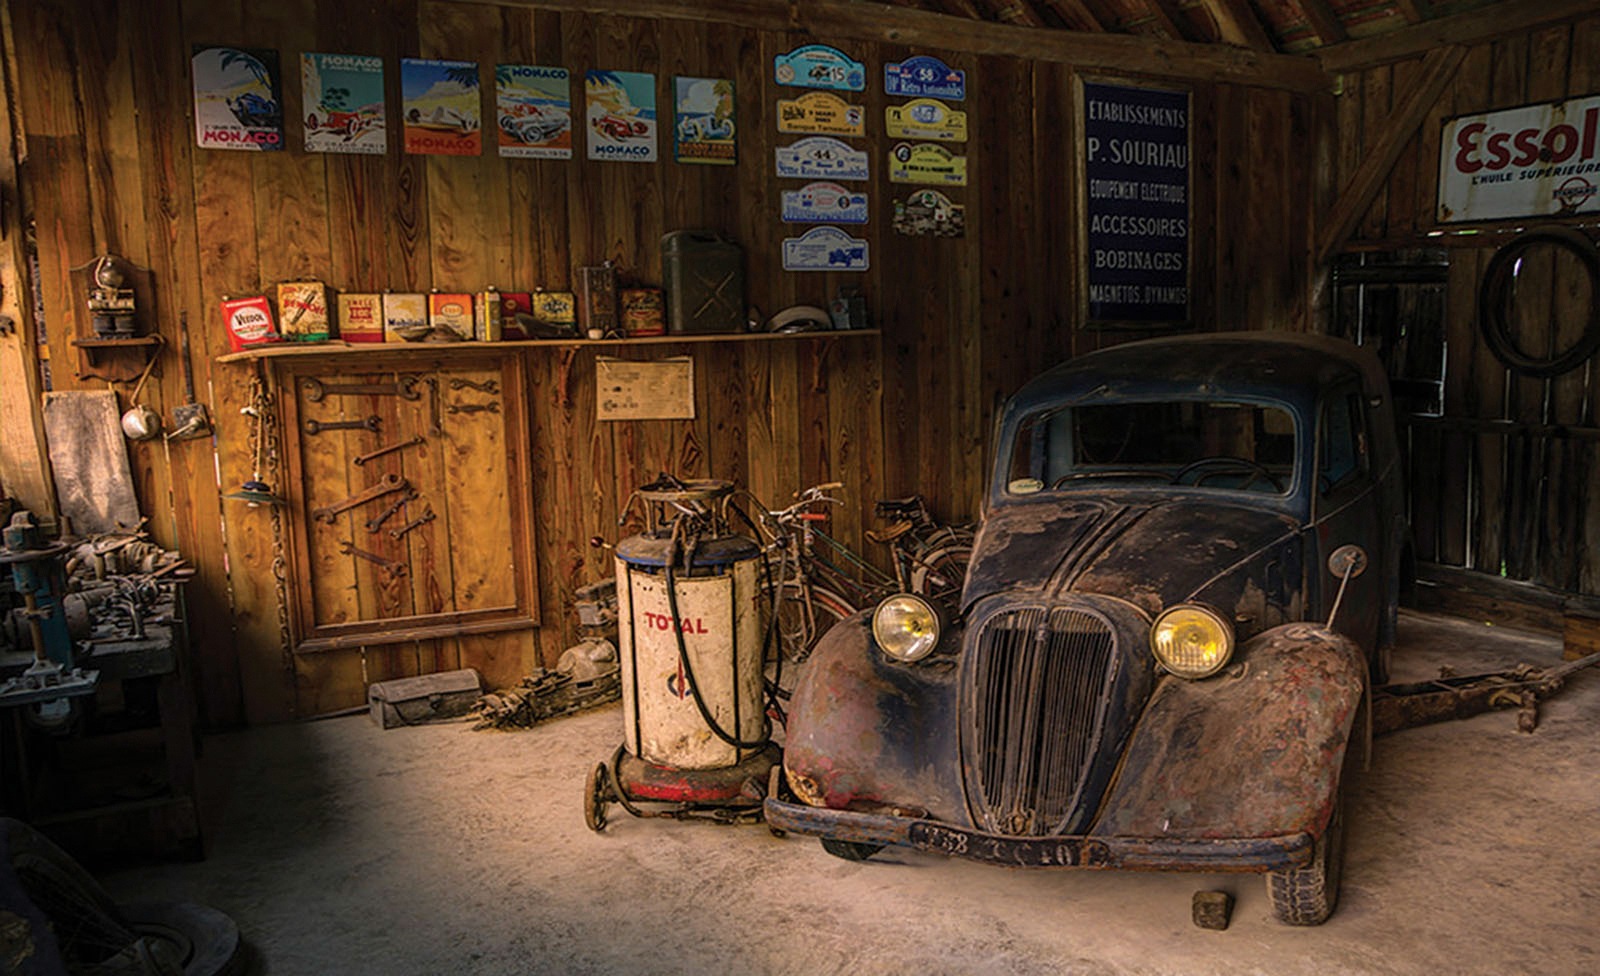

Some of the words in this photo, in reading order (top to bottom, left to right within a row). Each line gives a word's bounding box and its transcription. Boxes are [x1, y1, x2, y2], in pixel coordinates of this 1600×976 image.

[322, 56, 382, 68] MONACO
[512, 68, 568, 79] MONACO
[831, 67, 845, 81] 15
[203, 131, 280, 144] MONACO
[410, 137, 475, 149] MONACO
[595, 145, 650, 155] MONACO
[814, 150, 830, 159] 44
[1109, 138, 1186, 169] SOURIAU
[1472, 172, 1513, 185] L'HUILE
[1090, 214, 1186, 238] ACCESSOIRES
[1094, 249, 1183, 271] BOBINAGES
